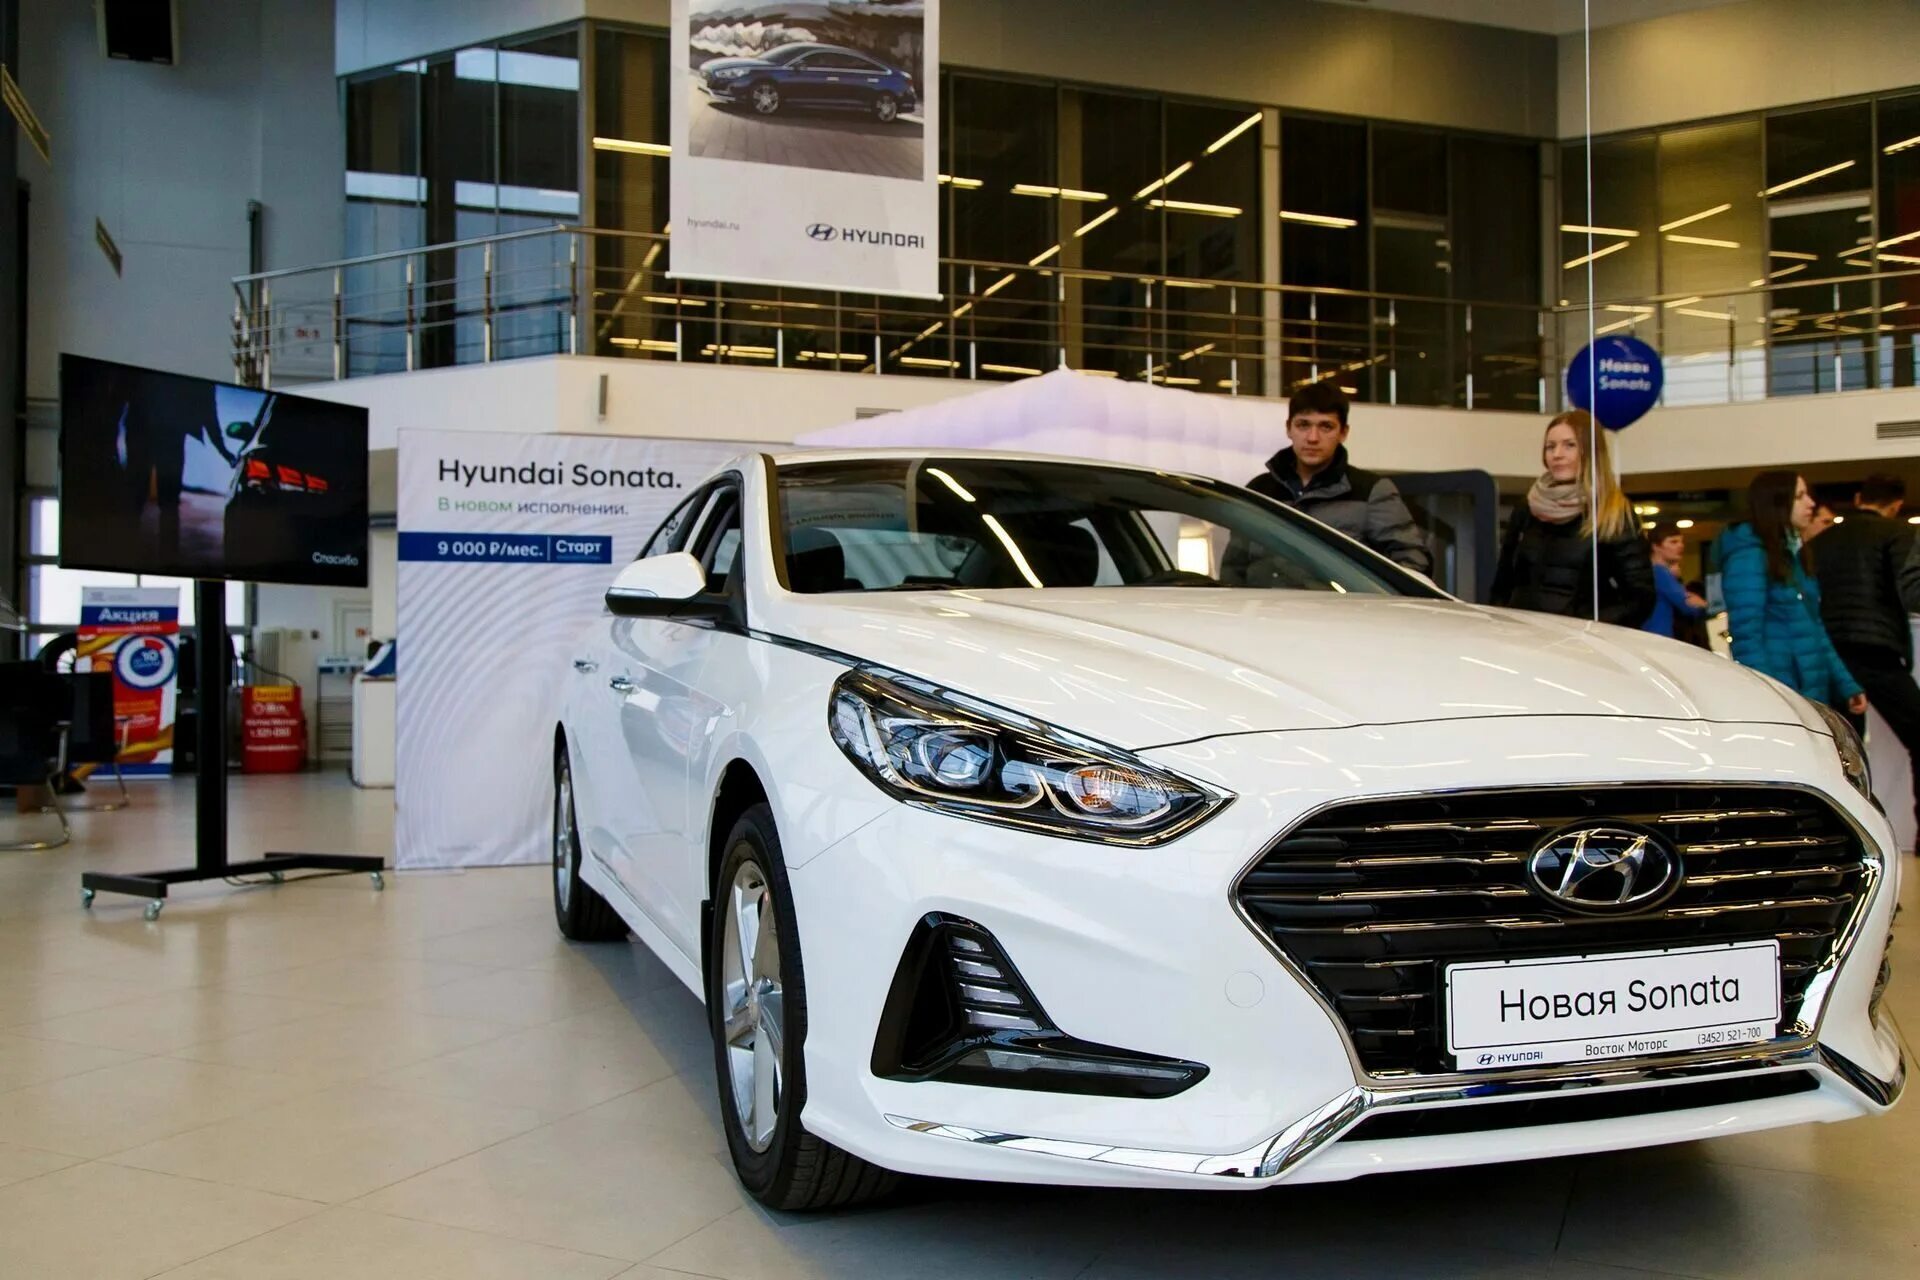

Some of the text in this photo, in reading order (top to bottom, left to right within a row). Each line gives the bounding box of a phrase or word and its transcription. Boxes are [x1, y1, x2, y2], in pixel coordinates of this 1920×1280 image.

[687, 217, 740, 231] hyundai.ru
[842, 228, 925, 249] HYUNDAI
[438, 458, 682, 489] Hyundai Sonata.
[438, 497, 629, 516] В новом исполнении.
[437, 541, 447, 555] 9
[452, 541, 486, 556] 000
[555, 539, 602, 556] Старт
[312, 552, 359, 567] Спасибо
[98, 608, 159, 624] Акция
[1499, 974, 1740, 1023] Новая Sonata
[1697, 1026, 1762, 1047] (3452) 521-700
[1585, 1037, 1668, 1057] Восток Моторс
[1497, 1050, 1544, 1063] HYUNDAI
